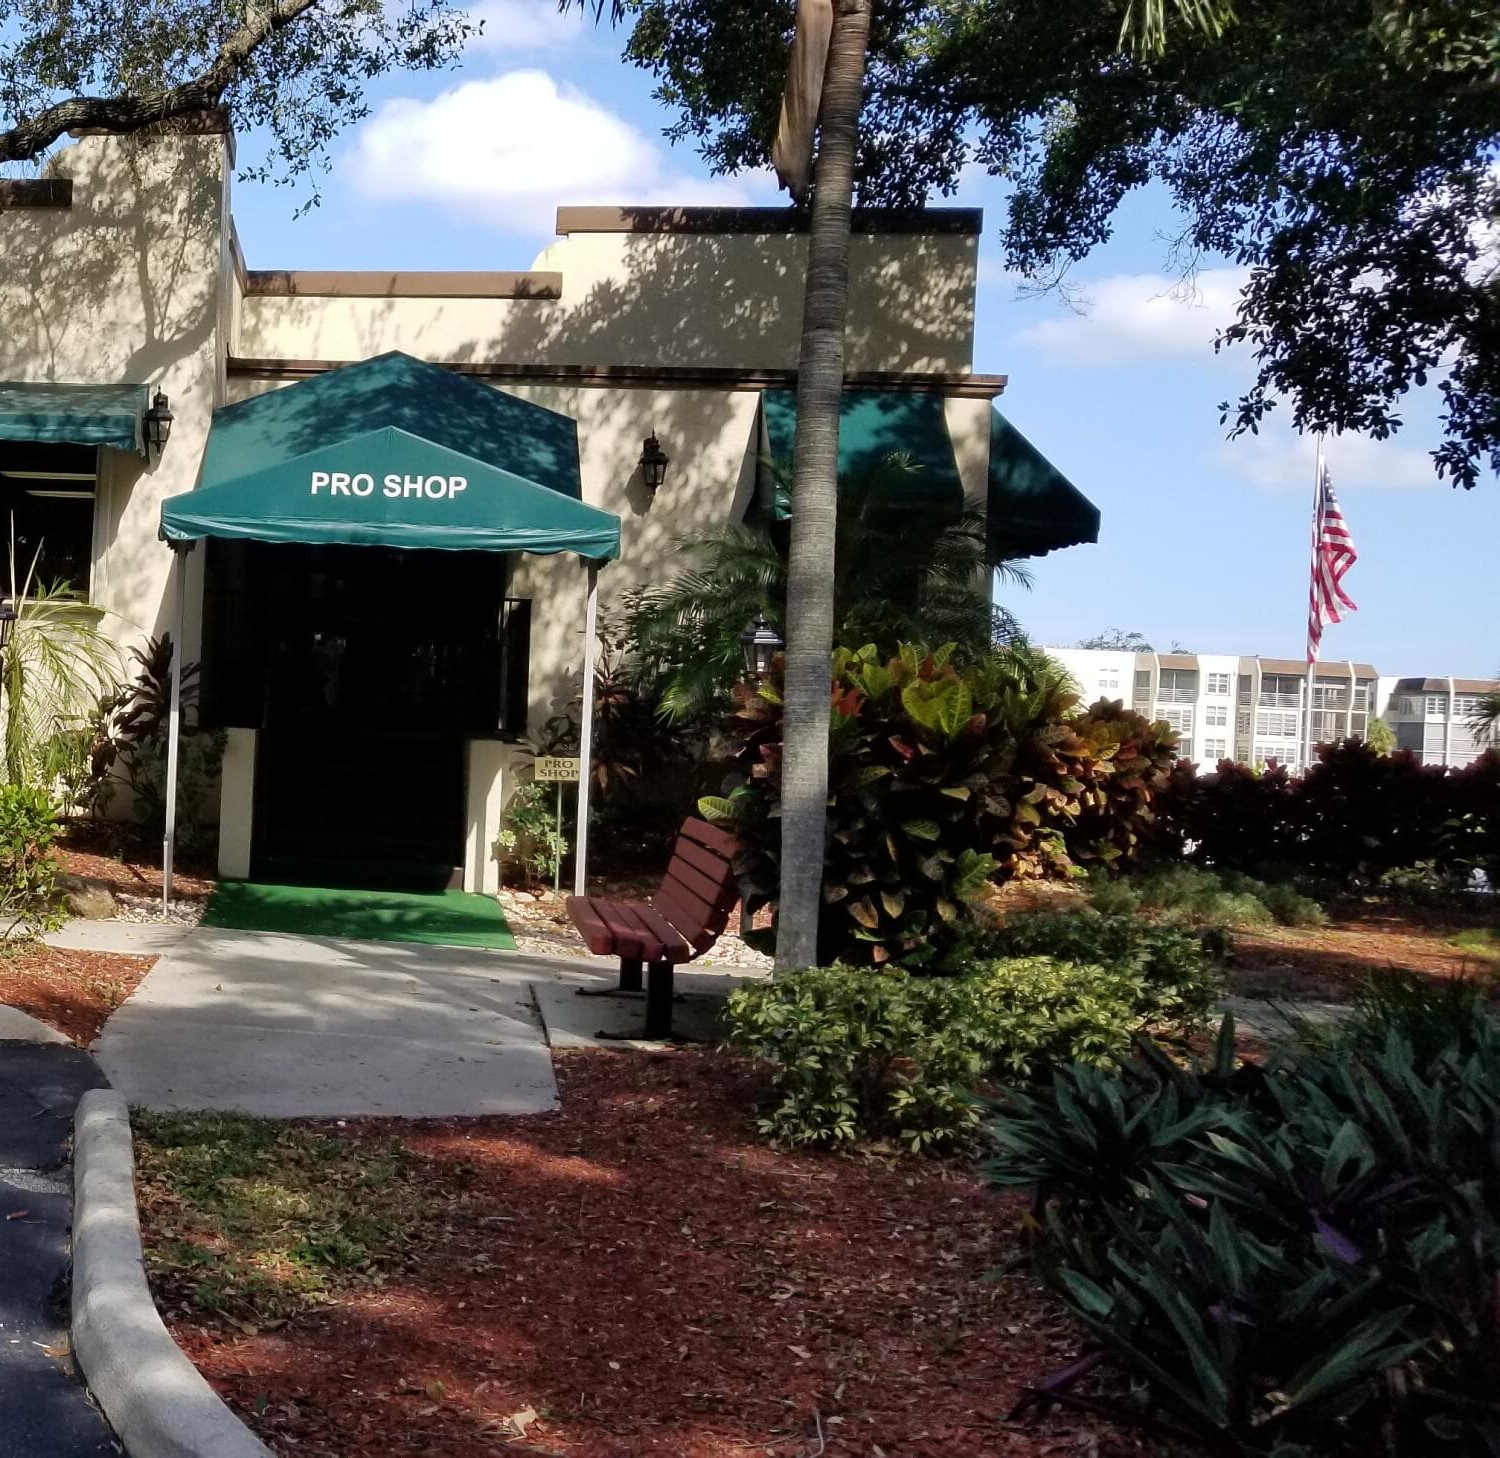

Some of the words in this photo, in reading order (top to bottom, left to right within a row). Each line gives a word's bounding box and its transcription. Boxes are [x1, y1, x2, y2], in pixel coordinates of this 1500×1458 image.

[310, 471, 374, 497] PRO
[382, 474, 468, 499] SHOP
[544, 760, 574, 768] PRO
[539, 769, 579, 778] SHOP
